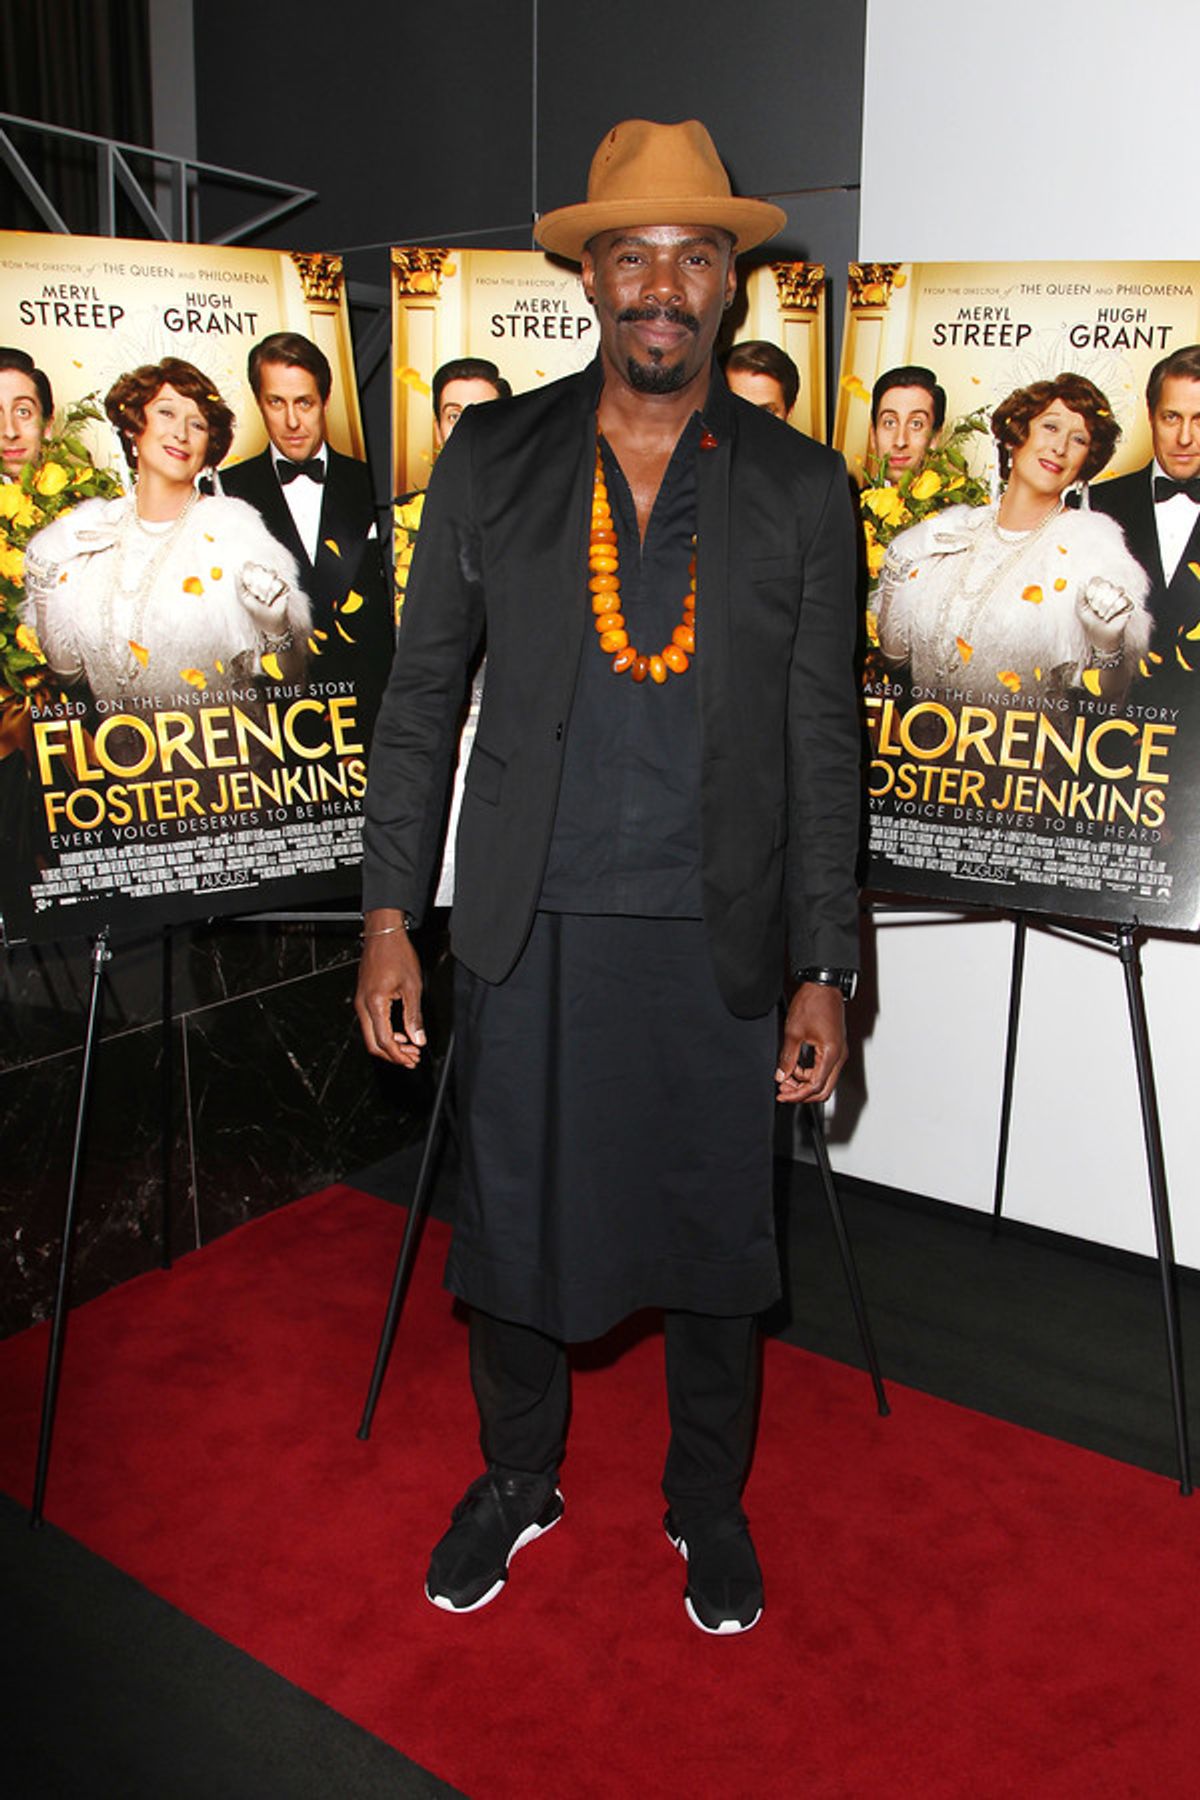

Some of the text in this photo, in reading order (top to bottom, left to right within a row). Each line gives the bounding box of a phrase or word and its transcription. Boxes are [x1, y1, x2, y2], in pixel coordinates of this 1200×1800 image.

[103, 263, 125, 276] THE
[130, 264, 174, 278] QUEEN
[198, 270, 269, 285] PHILOMENA
[42, 284, 100, 301] MERYL
[186, 292, 233, 309] HUGH
[1020, 283, 1042, 295] THE
[1046, 284, 1091, 296] QUEEN
[1116, 284, 1193, 297] PHILOMENA
[19, 300, 125, 329] STREEP
[514, 299, 569, 313] MERYL
[957, 306, 1011, 321] MERYL
[1098, 308, 1148, 323] HUGH
[163, 308, 258, 335] GRANT
[491, 314, 592, 339] STREEP
[932, 323, 1033, 347] STREEP
[1069, 324, 1173, 350] GRANT
[31, 681, 356, 719] BASED ON THE INSPIRING TRUE STORY
[864, 682, 1180, 723] ASED ON THE INSPIRING TRUE STORY
[33, 696, 364, 785] FLORENCE
[44, 759, 367, 833] FOSTER JENKINS
[868, 760, 1166, 829] OSTER JENKINS
[50, 799, 361, 849] EVERY VOICE DESERVES TO BE HEAR
[894, 800, 945, 818] VOICE
[954, 807, 1035, 828] DESERVES
[1044, 817, 1067, 832] TO
[1075, 821, 1095, 836] BE
[1104, 825, 1162, 843] HEARD
[201, 870, 249, 887] AUGUST
[960, 862, 1009, 880] AUGUST
